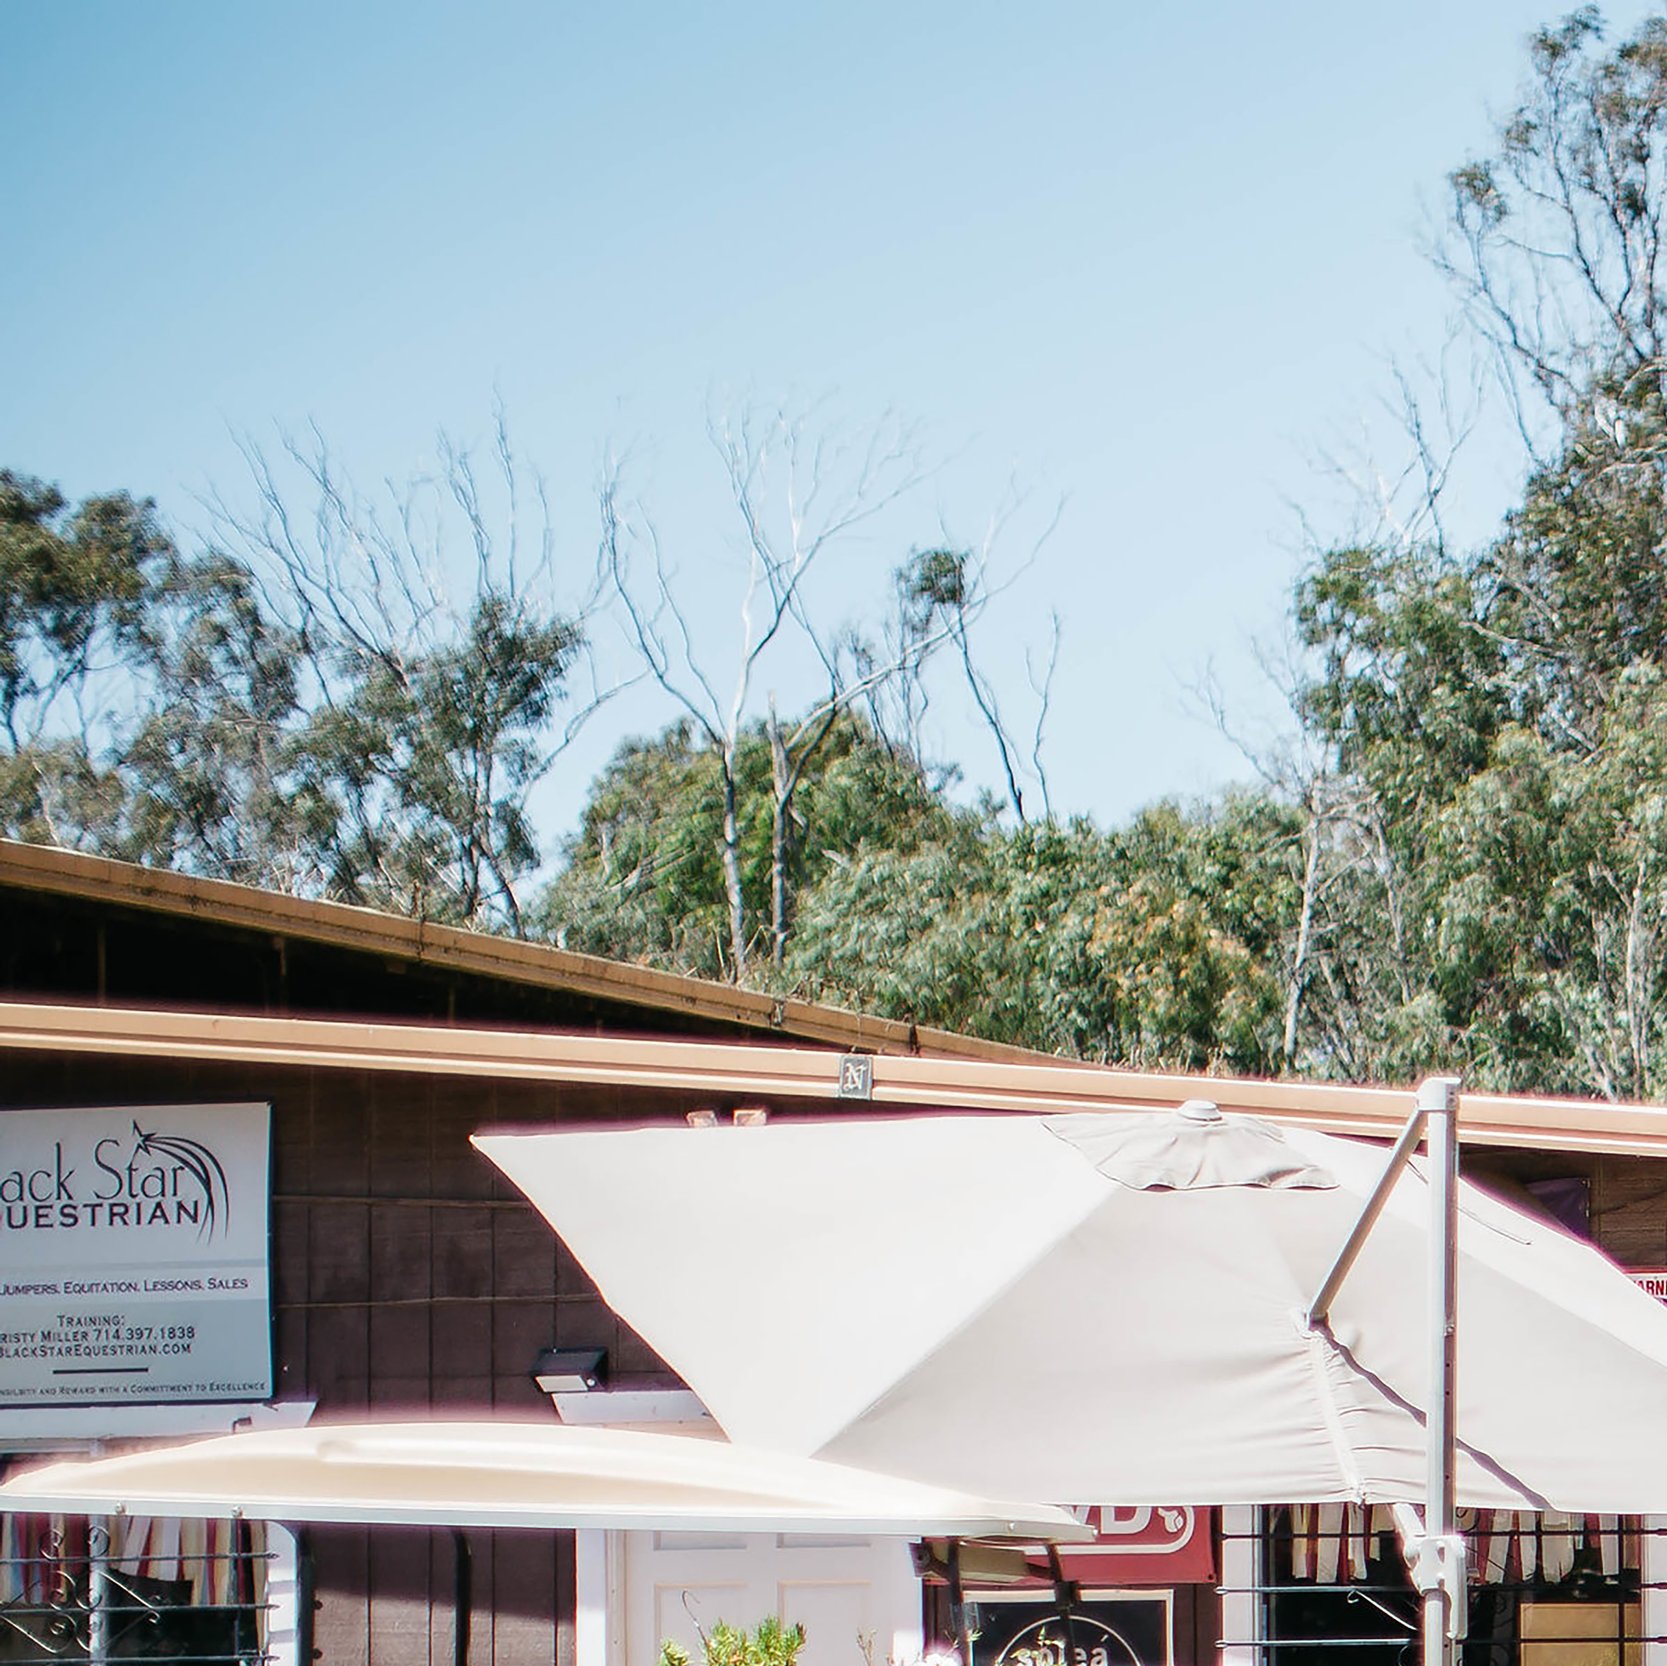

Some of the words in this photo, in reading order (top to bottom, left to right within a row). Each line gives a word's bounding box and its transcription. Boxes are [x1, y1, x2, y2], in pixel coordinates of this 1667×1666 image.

[93, 1138, 186, 1200] Star
[0, 1200, 199, 1229] UESTRIAN
[207, 1278, 249, 1290] SALES
[57, 1314, 125, 1328] TRAINING:
[40, 1330, 89, 1342] MILLER
[93, 1326, 195, 1341] 714.397.1838
[209, 1381, 265, 1392] EXCELLENCE
